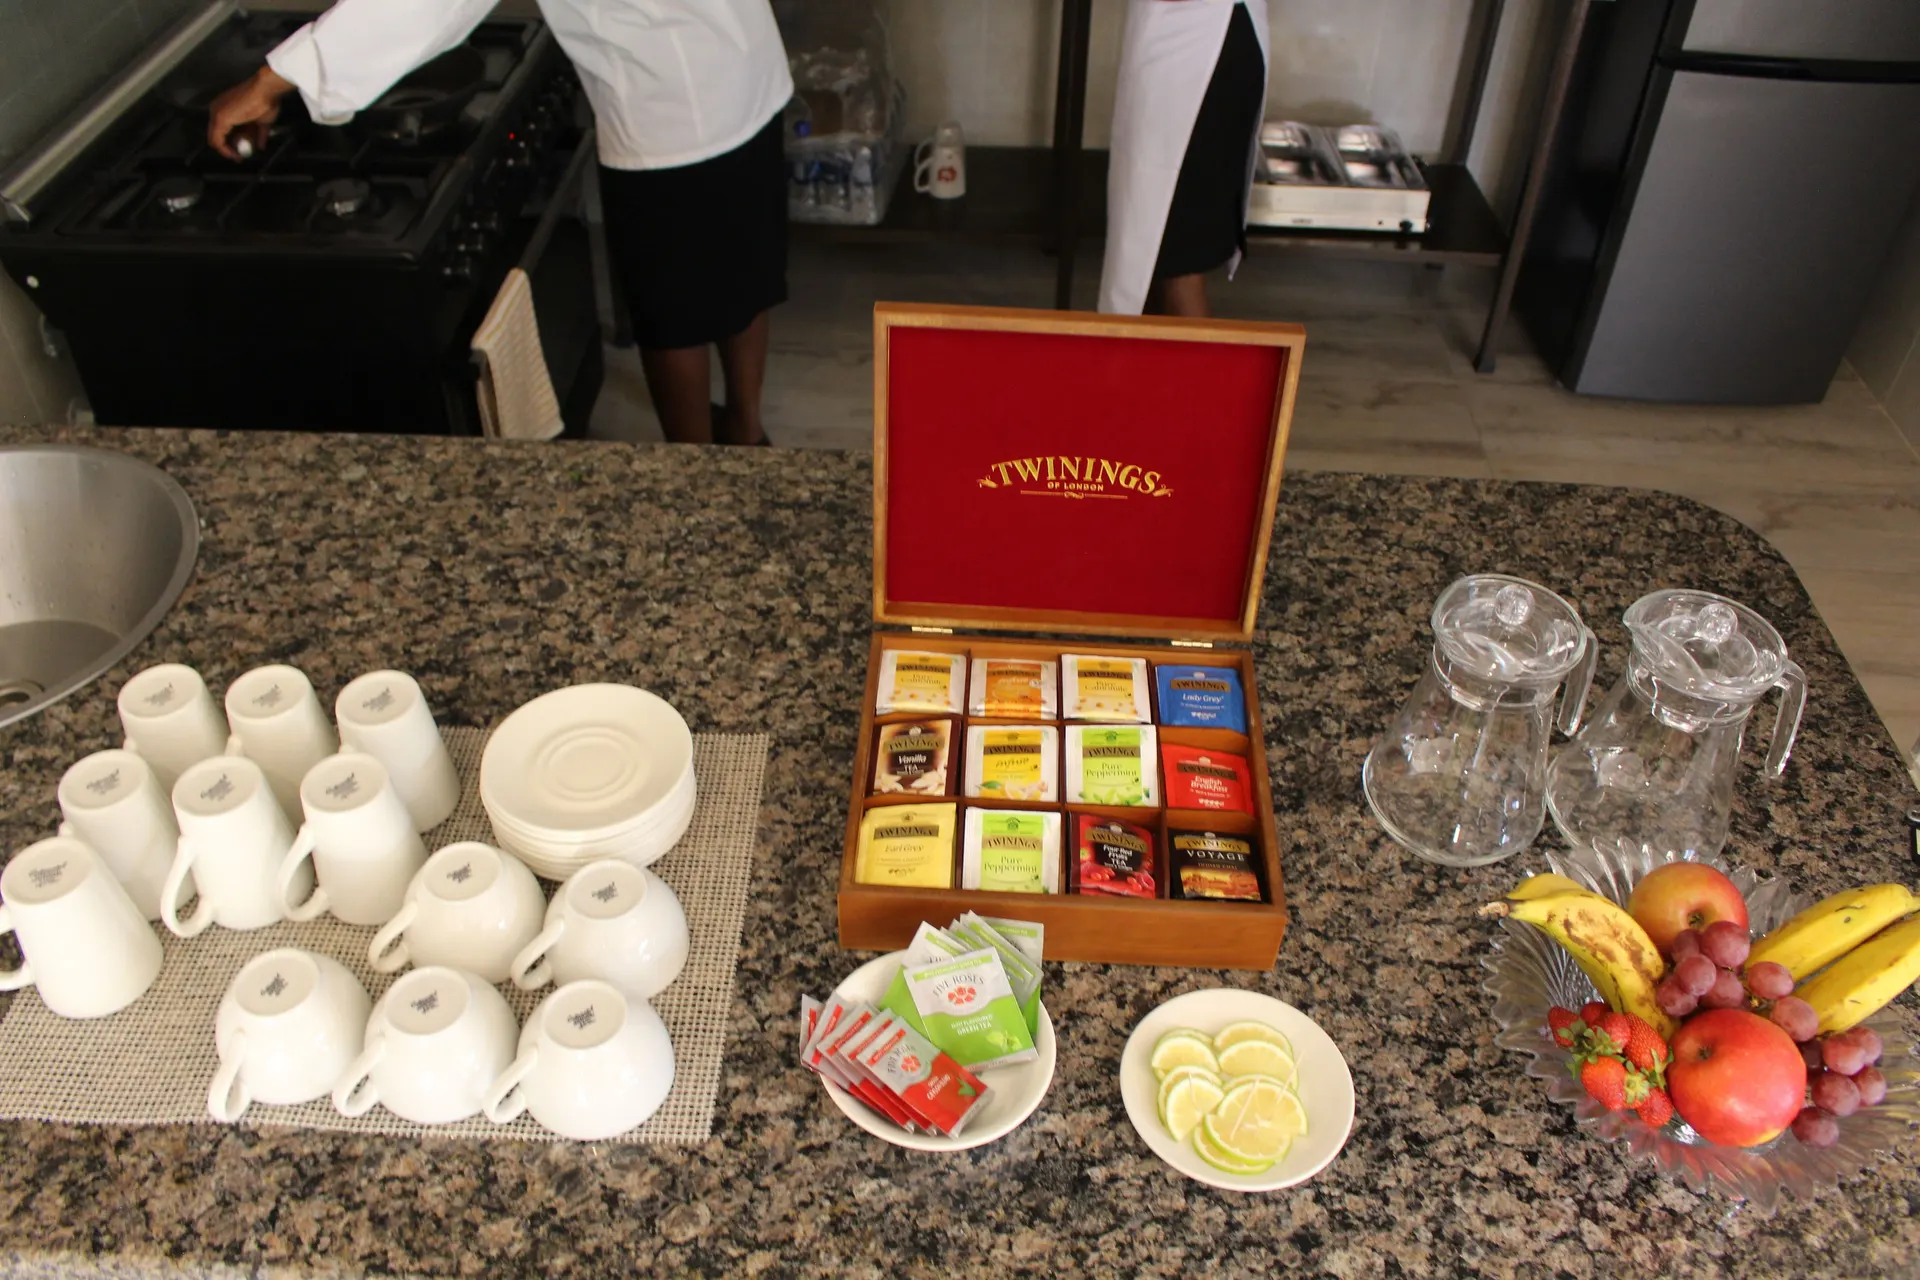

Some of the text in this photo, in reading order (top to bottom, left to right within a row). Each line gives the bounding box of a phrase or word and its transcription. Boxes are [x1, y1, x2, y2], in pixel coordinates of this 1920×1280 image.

[991, 455, 1162, 495] TWININGS
[1047, 481, 1104, 491] OF LONDON
[1176, 680, 1227, 691] TWININGS
[1182, 693, 1221, 704] Lady Grey
[888, 738, 941, 751] TWININGS
[989, 745, 1036, 755] TWININGS
[1088, 746, 1136, 758] TWININGS
[898, 753, 927, 765] Vanilla
[904, 763, 919, 773] TEA
[1102, 762, 1122, 770] Pure
[1086, 769, 1137, 779] Peppermint
[1190, 780, 1229, 793] Breakfast
[1195, 775, 1223, 786] English
[879, 825, 934, 839] TWININGS
[987, 836, 1038, 850] TWININGS
[1091, 832, 1147, 851] TWININGS
[1185, 839, 1244, 852] TWININGS
[1103, 844, 1133, 857] Four Red
[1108, 851, 1129, 862] Fruits
[1186, 849, 1245, 862] VOYAGE
[1001, 855, 1022, 864] Pure
[1111, 857, 1127, 867] TEA
[984, 862, 1038, 874] Peppermint
[932, 973, 985, 997] FIVE ROSES
